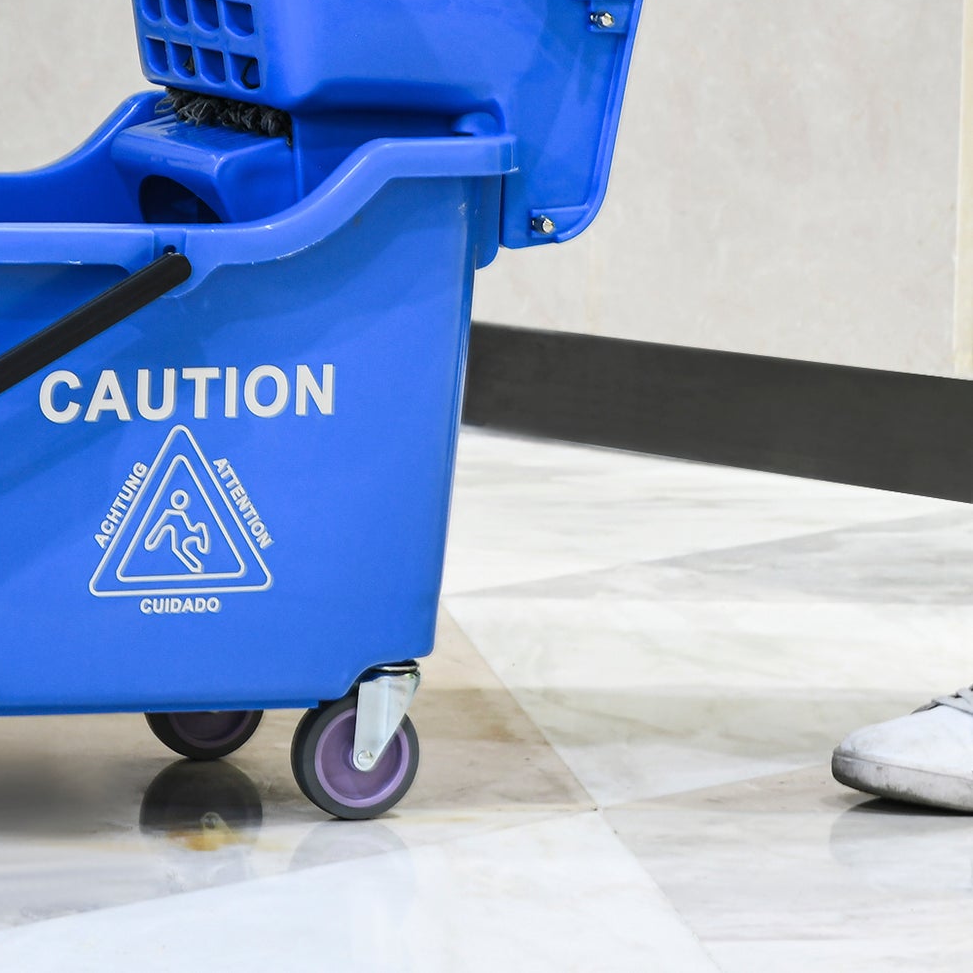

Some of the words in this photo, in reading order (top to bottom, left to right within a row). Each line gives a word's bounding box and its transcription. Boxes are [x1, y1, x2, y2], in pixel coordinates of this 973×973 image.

[39, 363, 335, 423] CAUTION
[93, 461, 149, 549] ACHTUNG
[212, 458, 274, 549] ATTENTION
[139, 597, 220, 614] CUIDADO
